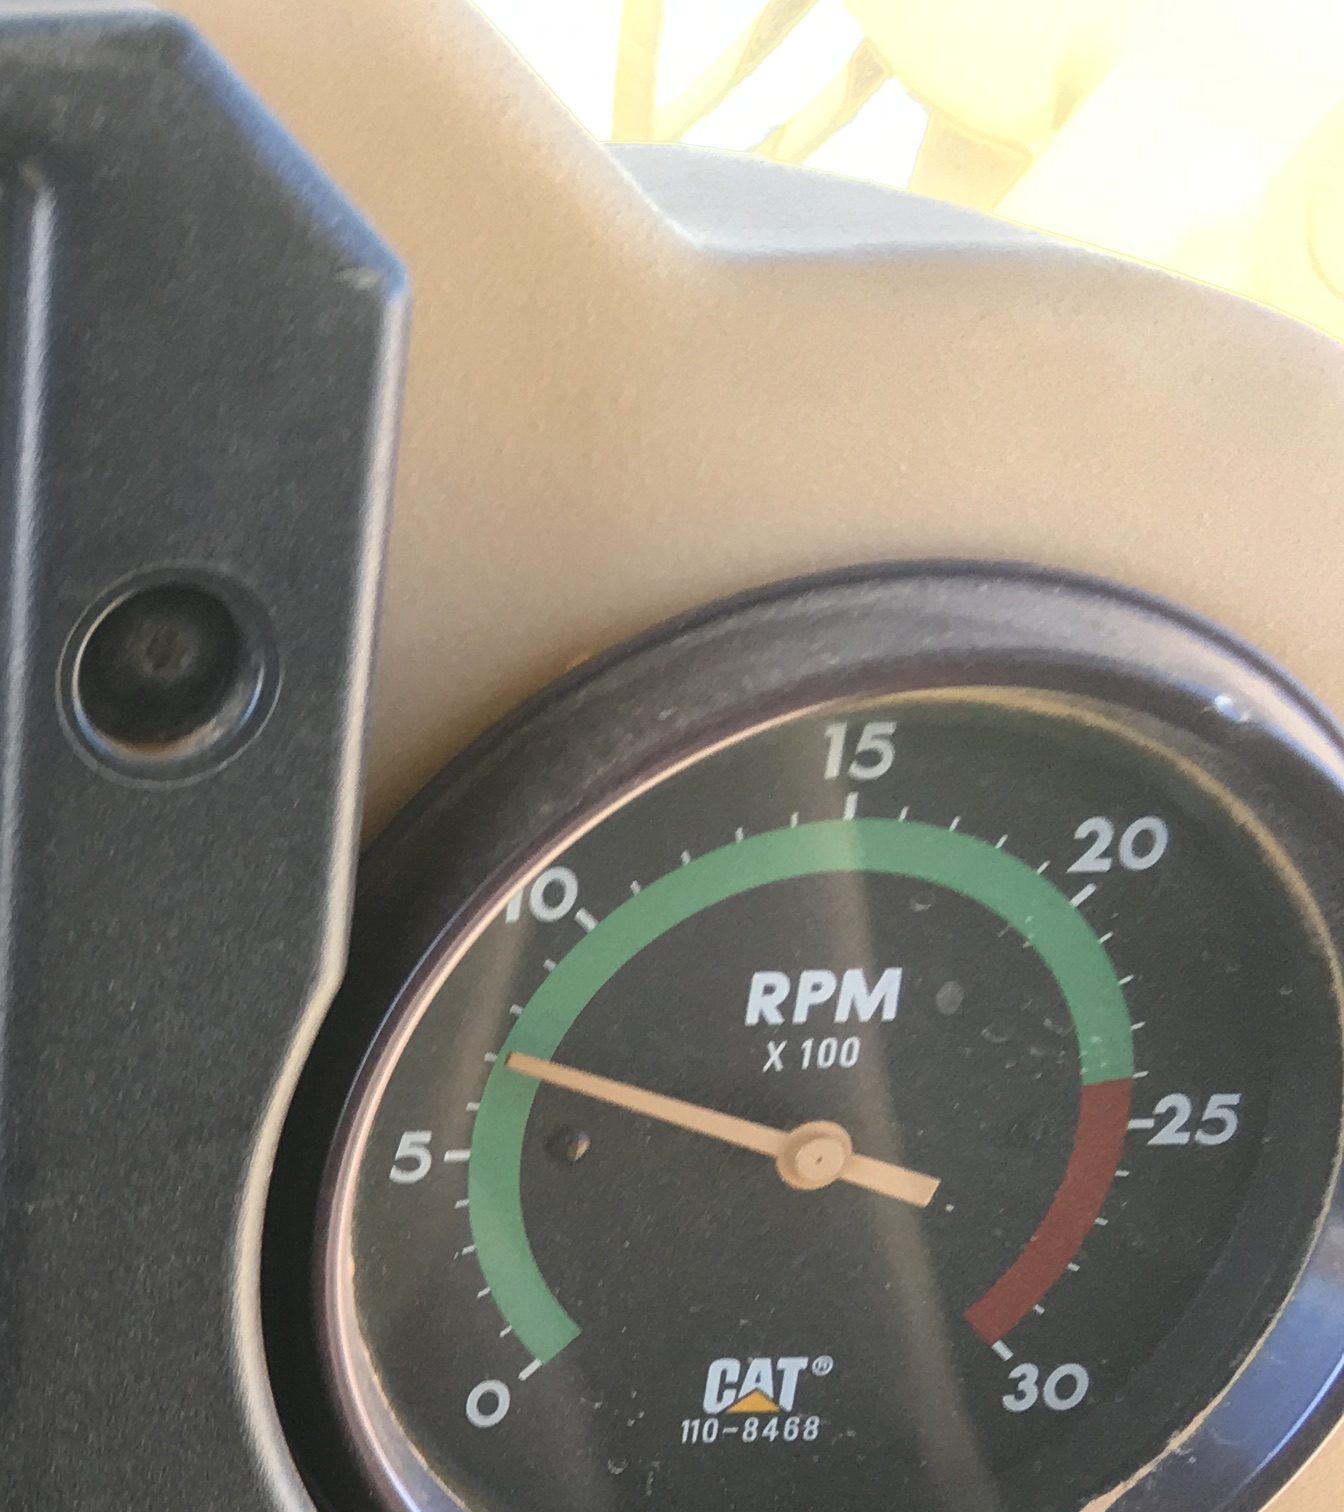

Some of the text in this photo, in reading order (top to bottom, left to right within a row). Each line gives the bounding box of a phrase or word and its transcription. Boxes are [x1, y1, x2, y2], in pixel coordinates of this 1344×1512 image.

[824, 722, 896, 780] 15
[1067, 817, 1169, 873] 20
[505, 866, 578, 923] 10
[745, 968, 903, 1027] RPM
[762, 1035, 861, 1073] X 100
[1148, 1093, 1242, 1146] 25
[390, 1131, 433, 1184] 5
[466, 1380, 511, 1428] 0
[1003, 1362, 1090, 1412] 30
[680, 1415, 821, 1444] 110-8468
